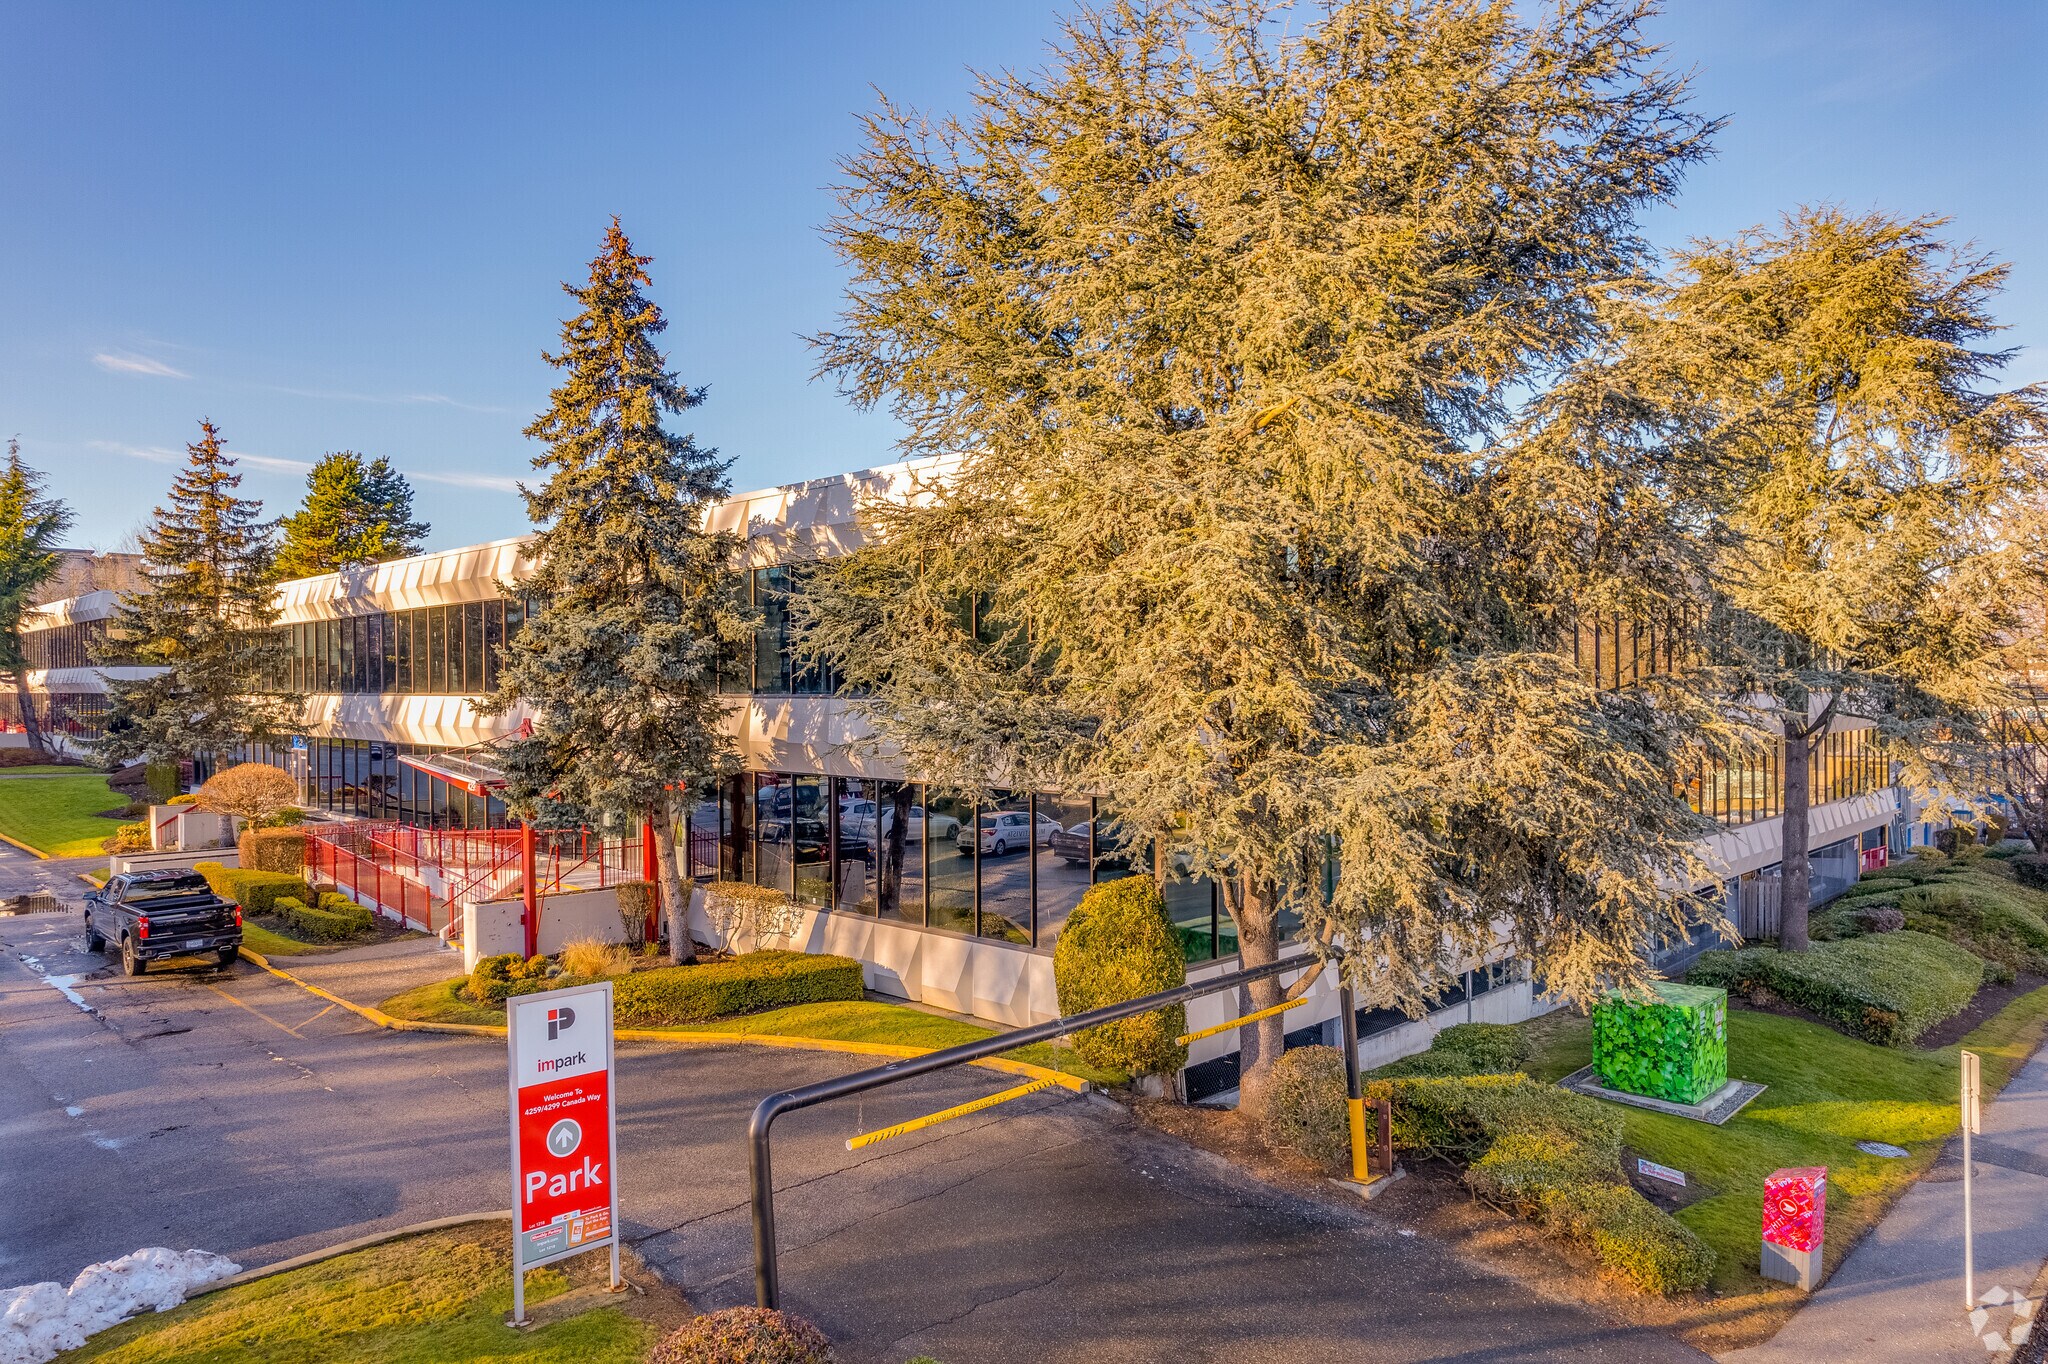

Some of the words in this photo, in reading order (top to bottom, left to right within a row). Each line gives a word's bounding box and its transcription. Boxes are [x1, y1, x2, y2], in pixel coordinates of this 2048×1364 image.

[537, 1051, 587, 1072] impark
[524, 1102, 560, 1115] 4259/4299
[561, 1096, 586, 1107] Canada
[586, 1093, 601, 1101] Way
[543, 1091, 574, 1102] Welcome
[924, 1110, 957, 1126] MAXIMUM
[958, 1099, 996, 1116] CLEARANCE
[526, 1156, 603, 1204] Park
